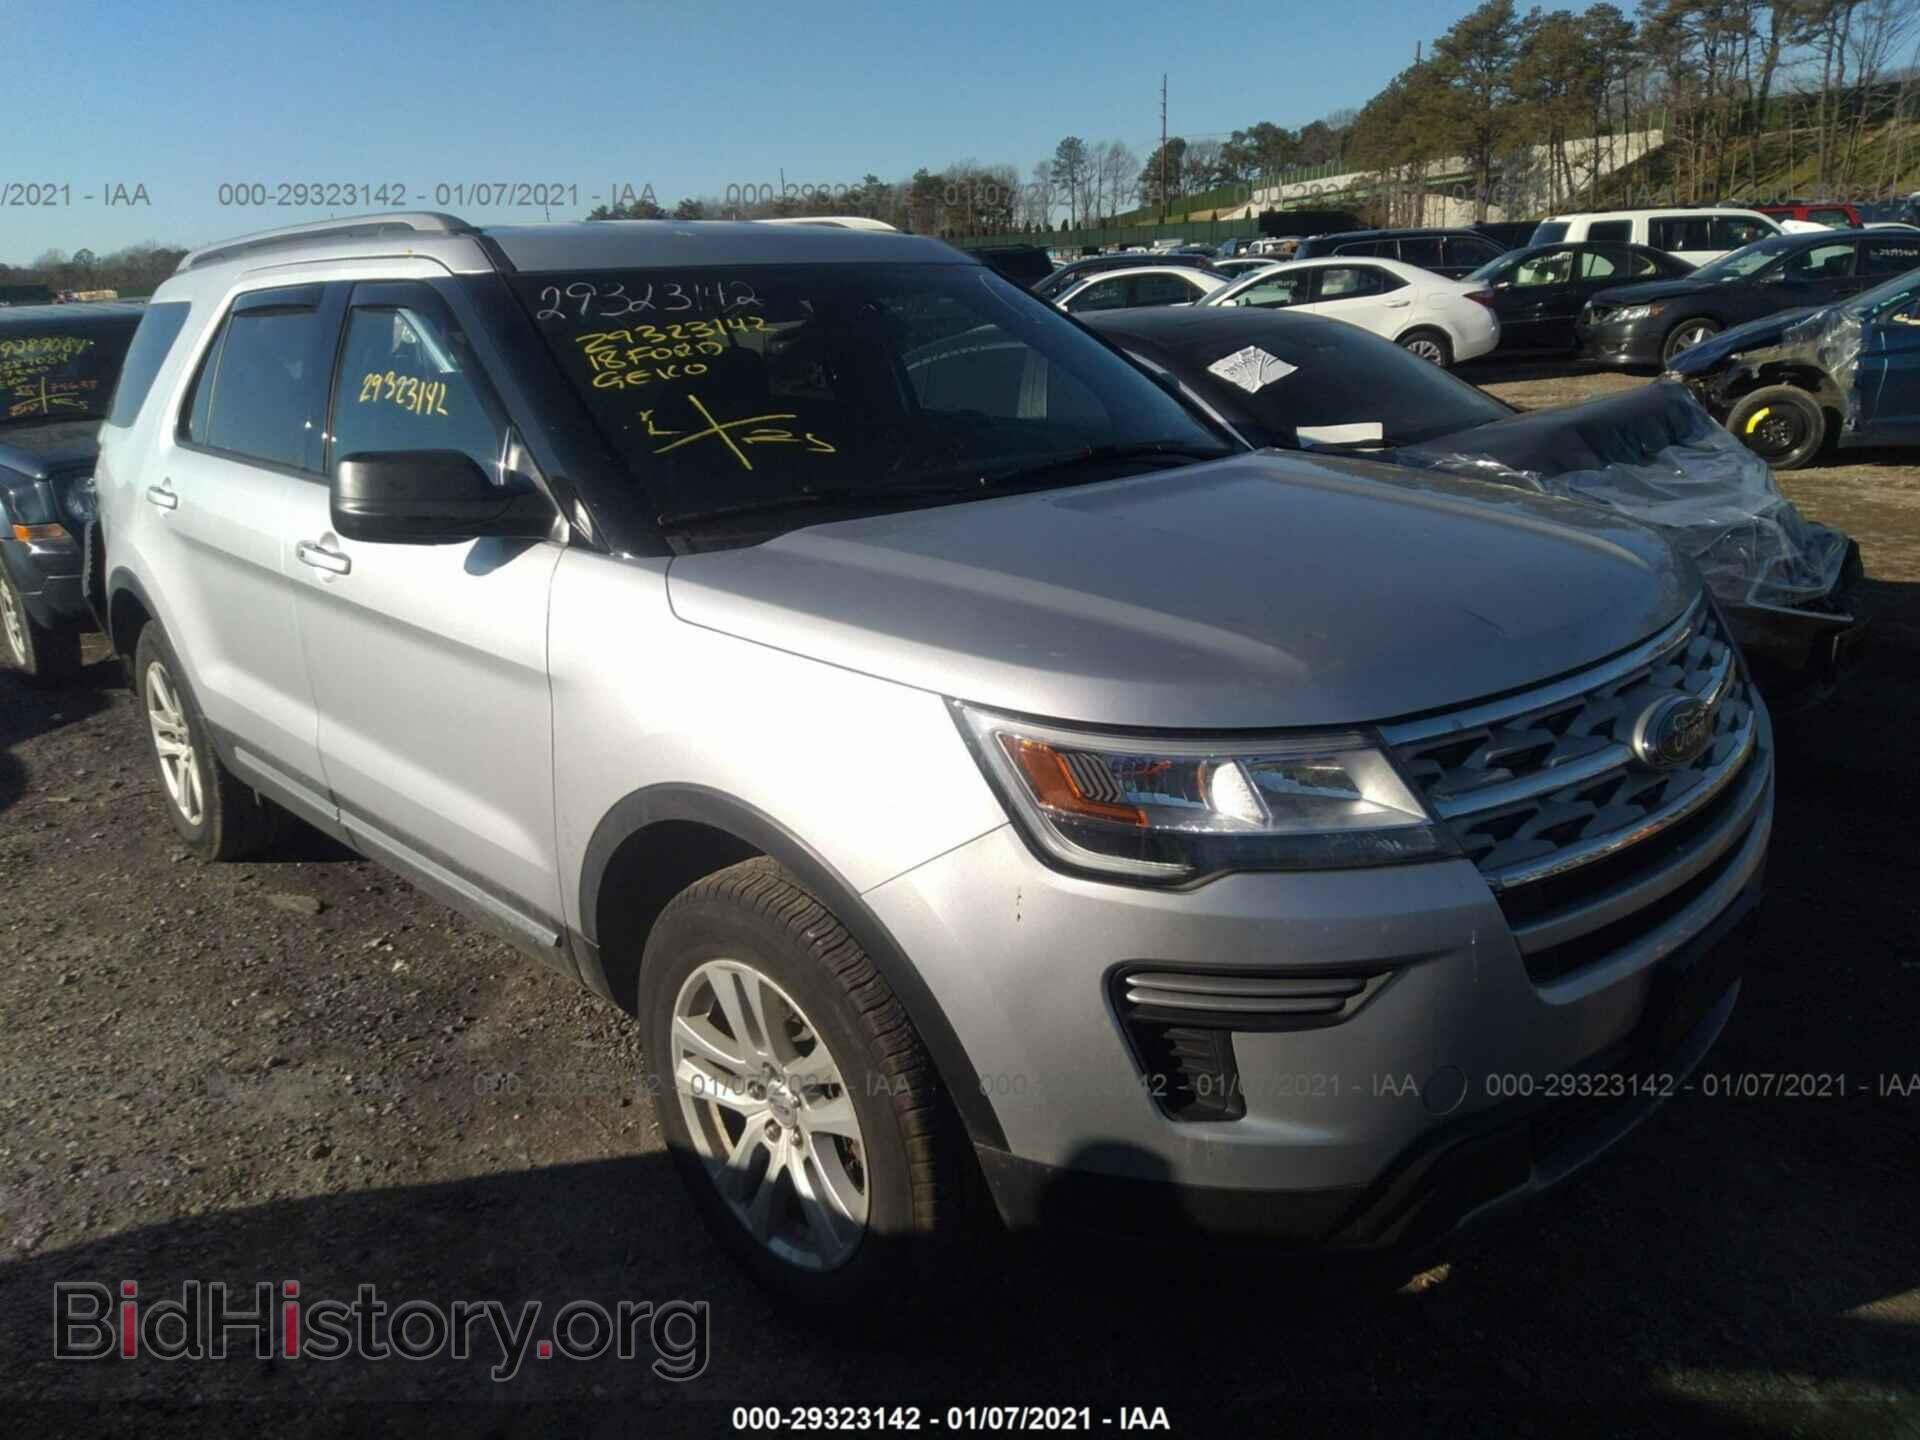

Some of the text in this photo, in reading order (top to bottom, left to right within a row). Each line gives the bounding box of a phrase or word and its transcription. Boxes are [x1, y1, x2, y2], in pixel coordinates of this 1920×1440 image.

[536, 281, 766, 320] 29323142
[576, 316, 779, 354] 29323142
[358, 371, 448, 416] 29323142
